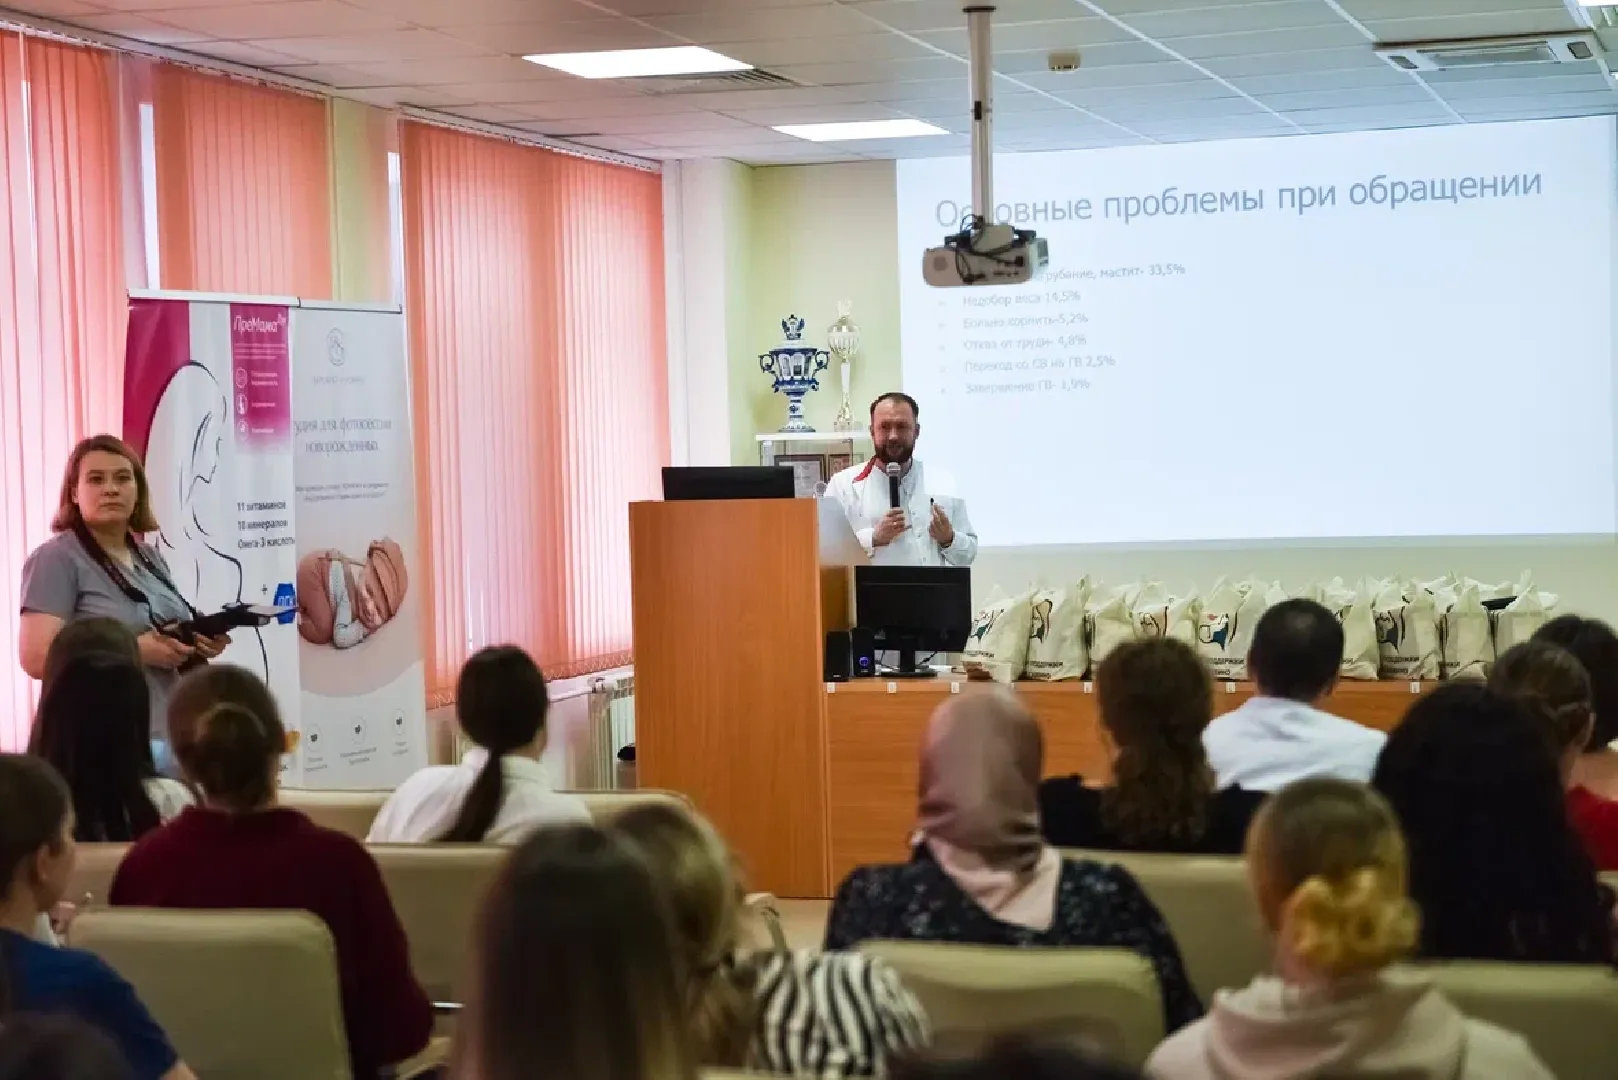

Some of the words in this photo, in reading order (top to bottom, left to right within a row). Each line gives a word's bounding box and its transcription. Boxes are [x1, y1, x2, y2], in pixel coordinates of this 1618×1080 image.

[935, 198, 1092, 227] Осовные
[1103, 186, 1263, 225] проблемы
[1278, 184, 1336, 215] при
[1349, 173, 1542, 209] обращении
[1148, 263, 1186, 277] 33,5%
[1045, 289, 1081, 304] 14,5%
[1058, 334, 1087, 349] 4,8%
[1085, 354, 1116, 368] 2,5%
[1061, 377, 1090, 391] 1,9%
